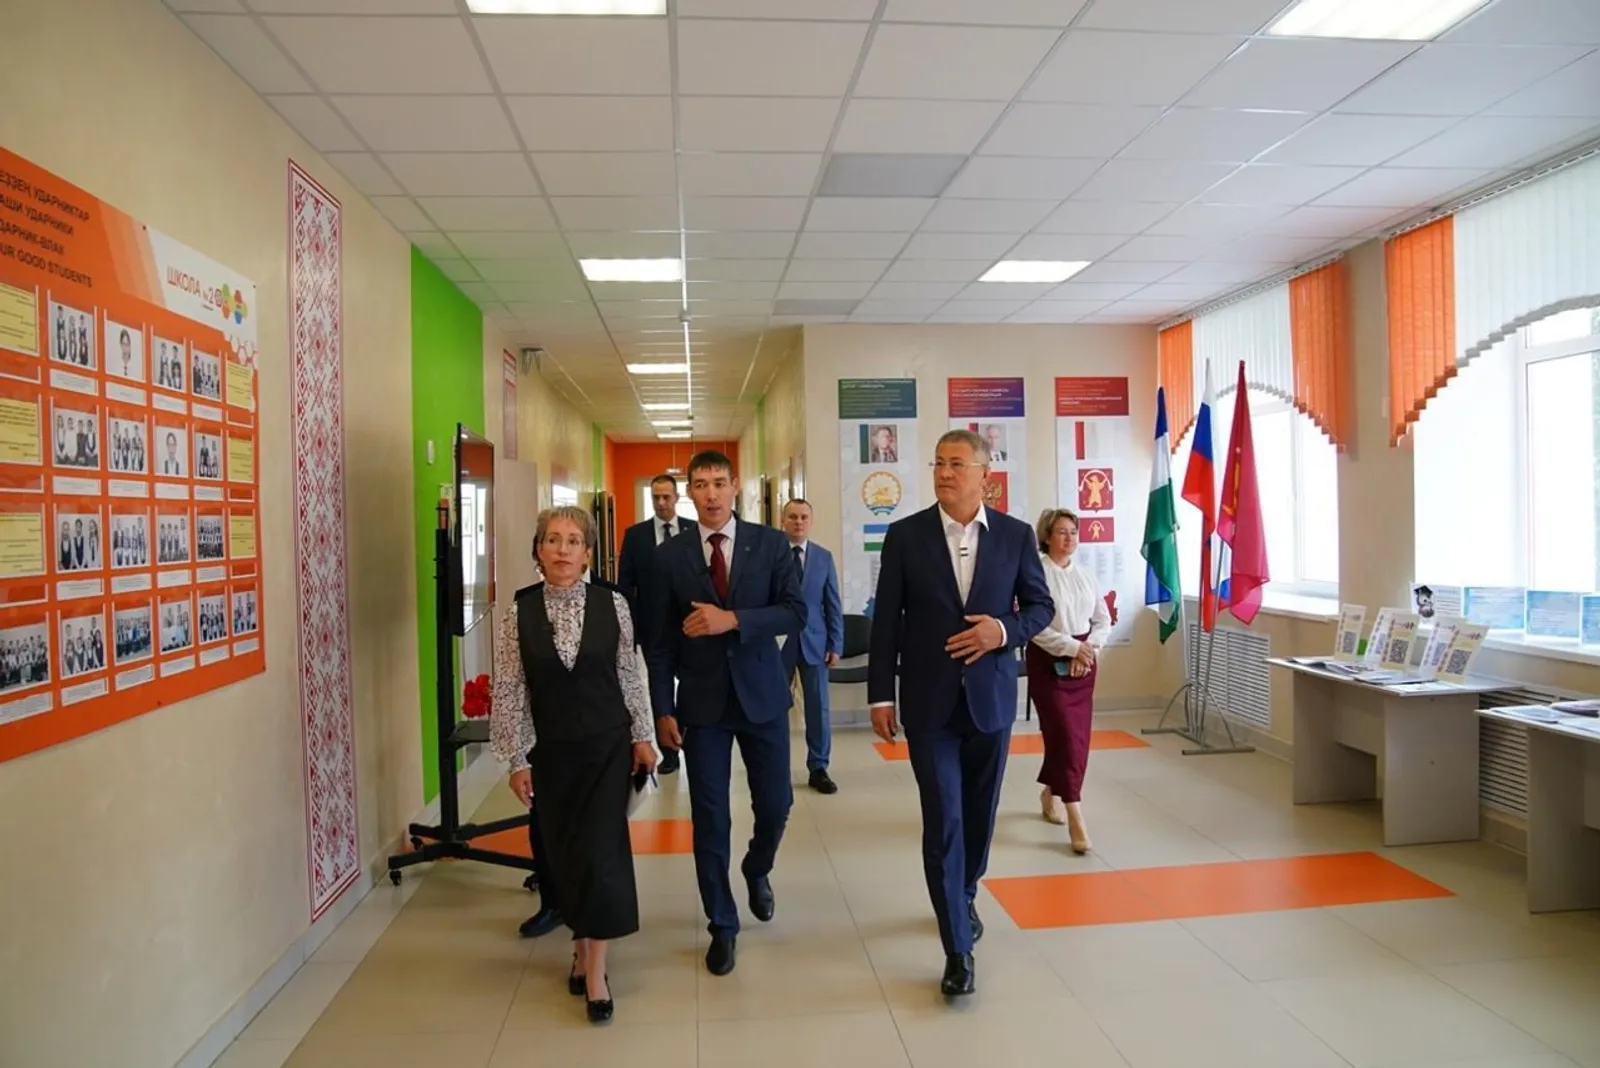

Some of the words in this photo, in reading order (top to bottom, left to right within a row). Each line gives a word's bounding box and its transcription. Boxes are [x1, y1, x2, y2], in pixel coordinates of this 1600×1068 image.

[0, 192, 22, 213] АШИ
[0, 242, 16, 259] UR
[17, 247, 46, 270] GOOD
[47, 260, 92, 288] STUDENTS
[166, 264, 201, 298] ШКОЛА
